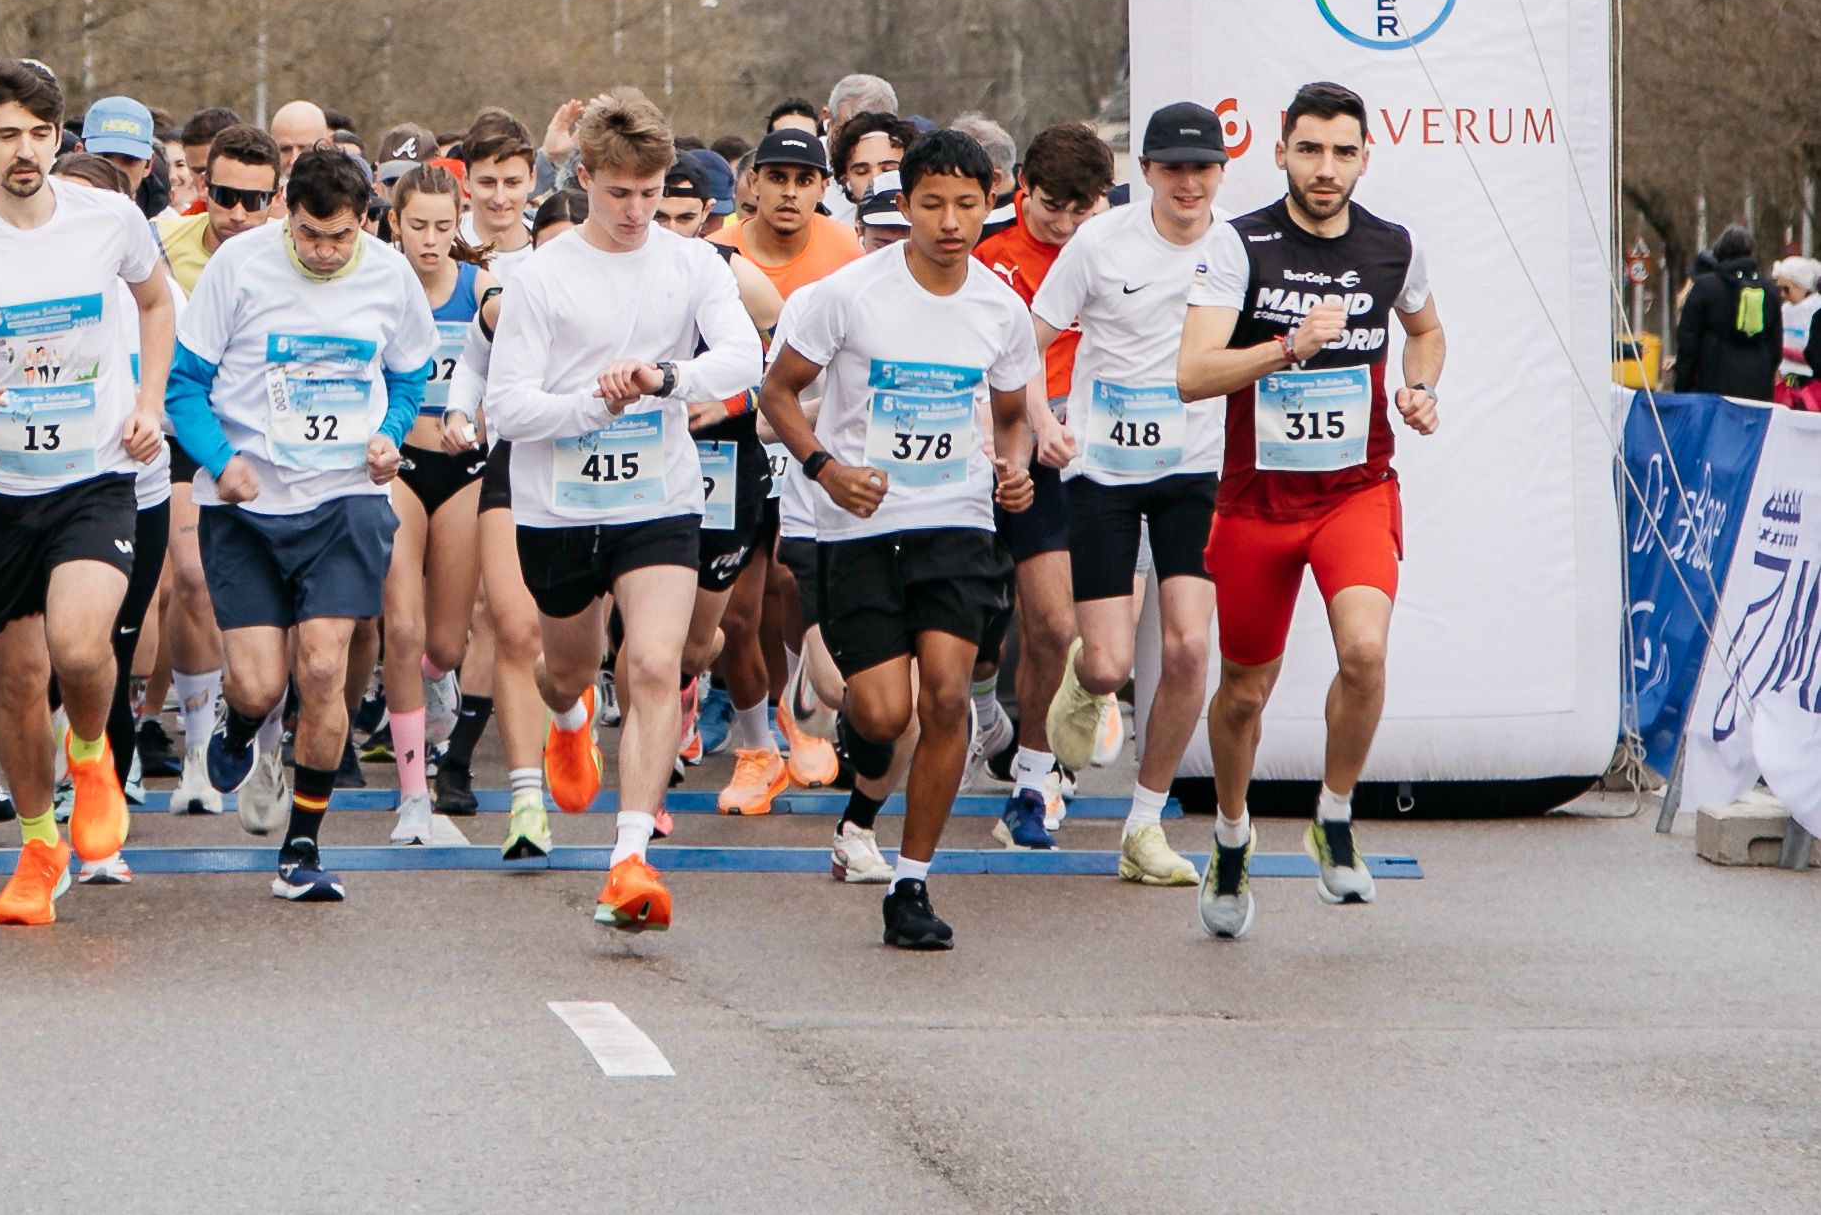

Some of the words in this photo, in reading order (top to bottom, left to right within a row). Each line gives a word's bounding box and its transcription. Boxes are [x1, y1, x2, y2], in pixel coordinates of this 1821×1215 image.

[1281, 108, 1555, 146] VERUM
[24, 424, 61, 451] 13
[304, 415, 339, 441] 32
[1109, 420, 1161, 447] 418
[1285, 410, 1345, 441] 315
[892, 432, 952, 461] 378
[580, 451, 640, 483] 415
